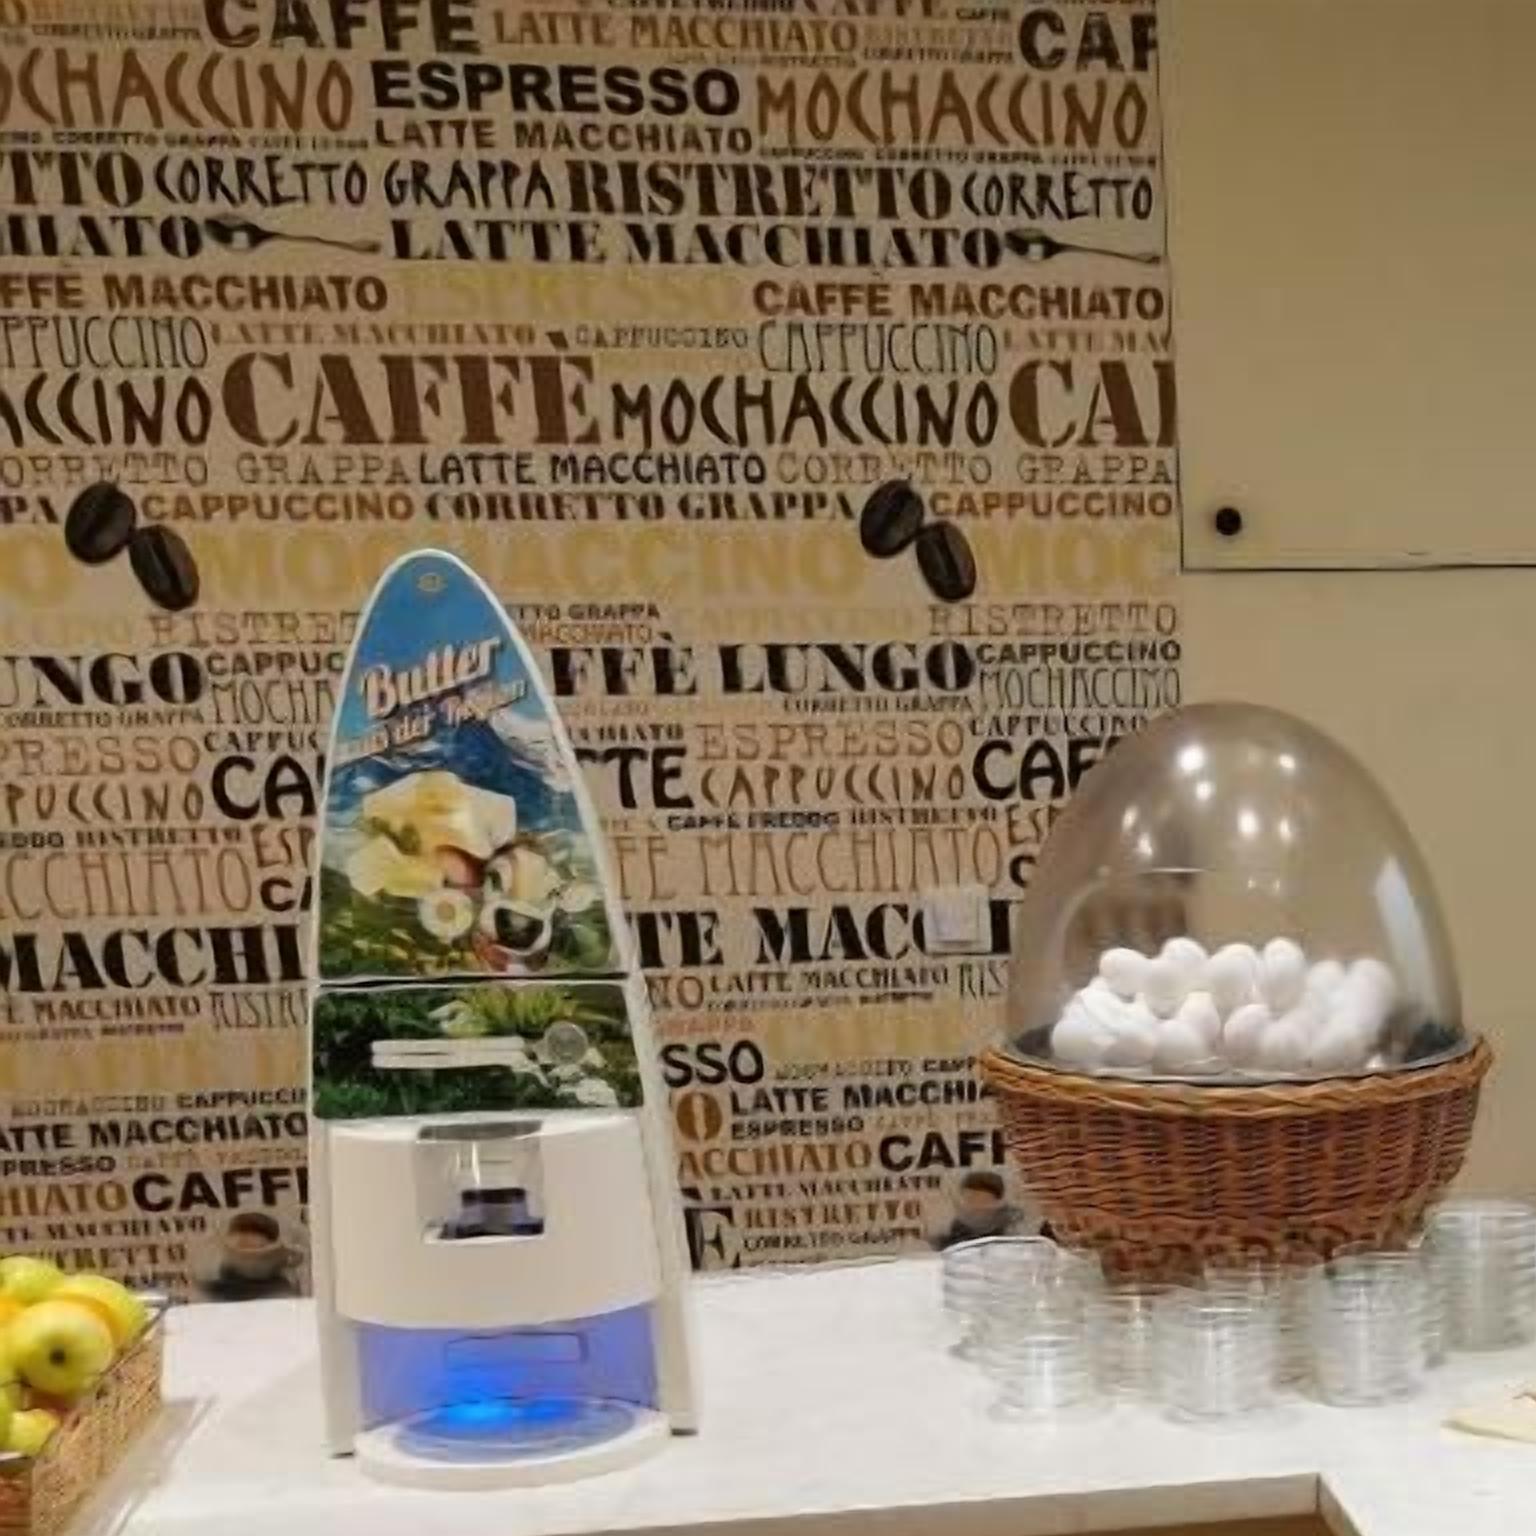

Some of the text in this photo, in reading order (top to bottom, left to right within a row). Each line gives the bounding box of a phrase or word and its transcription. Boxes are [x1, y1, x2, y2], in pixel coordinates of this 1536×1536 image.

[493, 11, 857, 52] LATTE MACCHIATO
[370, 60, 740, 116] ESPRESSO
[757, 69, 1148, 149] MOCHACCINO
[375, 119, 753, 154] LATTE MACCHIATO
[153, 155, 368, 209] CORRETTO
[384, 159, 556, 209] GRAPPA
[564, 160, 953, 221] RISTRETTO
[962, 170, 1153, 221] CORRETTO
[390, 219, 607, 262] LATTE
[625, 223, 1001, 269] MACCHIATO
[103, 274, 389, 312] MACCHIATO
[909, 284, 1165, 321] MACCHIATO
[576, 323, 749, 348] CAPPUCCINO
[759, 319, 998, 376] CAPPUCCINO
[611, 374, 999, 450] MOCHACCINO
[236, 452, 411, 485] GRAPPA
[420, 452, 536, 485] LATTE
[551, 451, 767, 484] MACCHIATO
[1015, 453, 1174, 485] GRAPPA
[141, 493, 415, 521] CAPPUCCINO
[425, 491, 664, 521] CORRETTO
[677, 491, 856, 520] GRAPPA
[928, 491, 1173, 518] CAPPUCCINO
[568, 604, 661, 621] GRAPPA
[928, 604, 1177, 637] RISTRETTO
[363, 636, 502, 721] Butter
[717, 641, 976, 694] LUNGO
[974, 639, 1182, 665] CAPPUCCINO
[979, 667, 1181, 710] MOCHACCINO
[696, 722, 965, 762] ESPRESSO
[700, 760, 964, 808] CAPPUCCINO
[729, 1089, 831, 1115] LATTE
[88, 1112, 308, 1149] MACCHIATO
[731, 1115, 864, 1141] ESPRESSO
